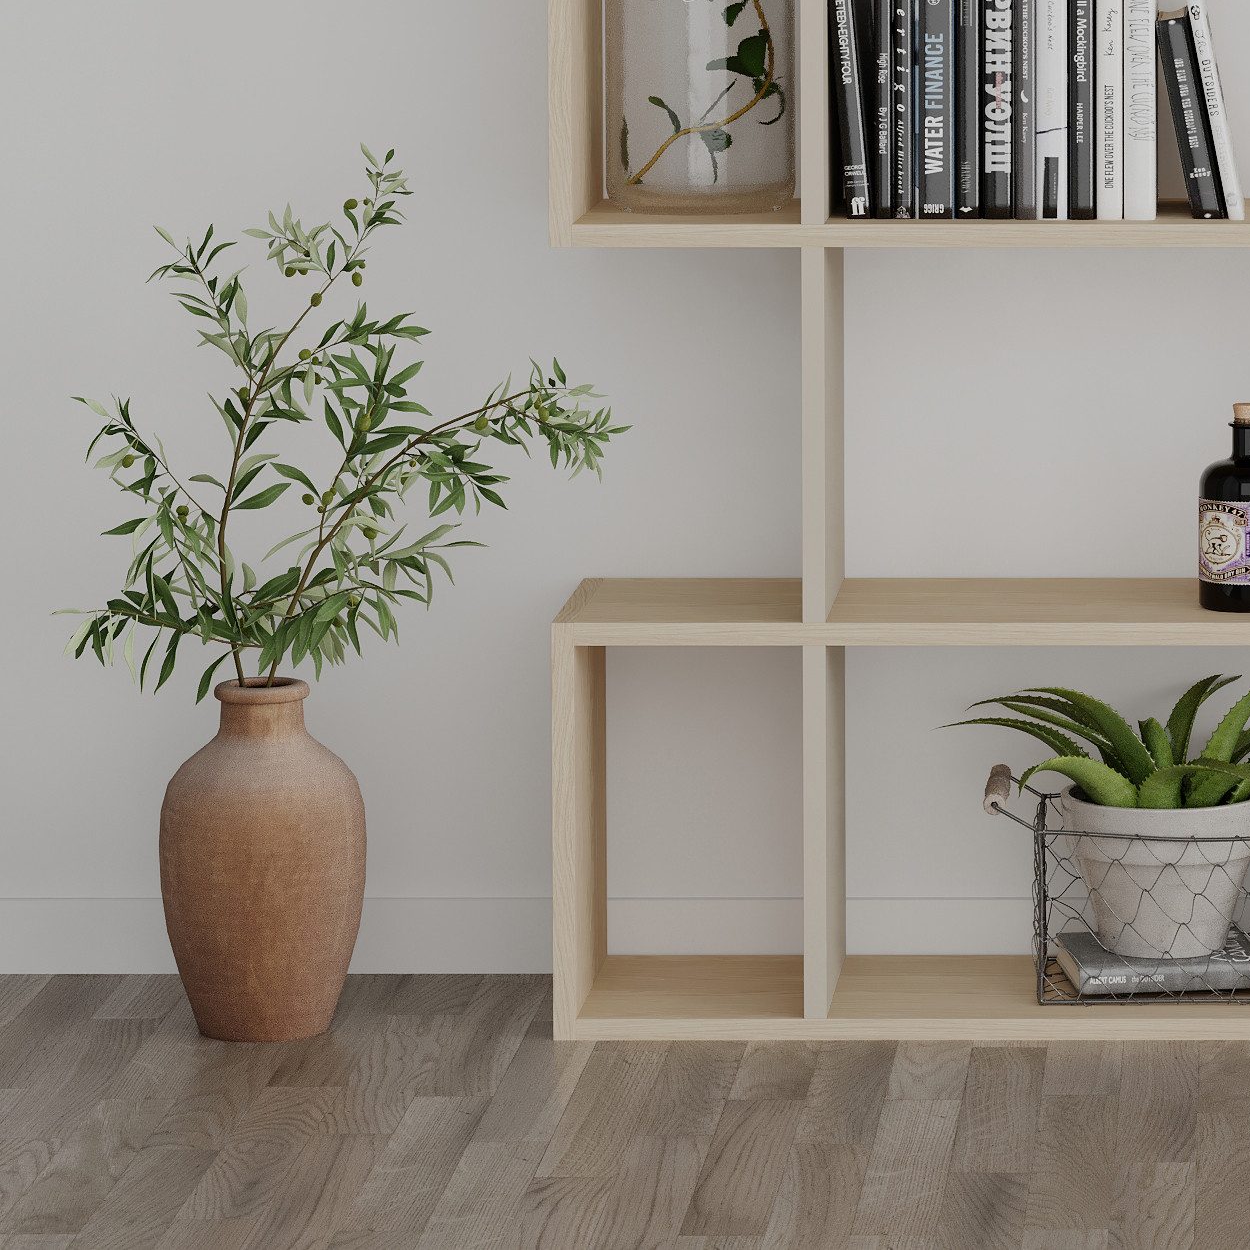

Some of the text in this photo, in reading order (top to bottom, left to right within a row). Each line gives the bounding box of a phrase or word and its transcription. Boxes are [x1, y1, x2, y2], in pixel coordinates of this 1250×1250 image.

[1074, 18, 1087, 82] Mockingbird
[840, 60, 852, 85] FOUR
[876, 52, 888, 84] High Rise
[1201, 59, 1219, 116] OUTSIDERS
[878, 107, 888, 117] By
[925, 33, 944, 175] WATER FINANCE
[878, 130, 888, 155] Ballard
[896, 119, 905, 147] Alfred
[1104, 84, 1114, 189] ONE FLEW OVER THE CUCKOO'S NEST
[923, 203, 944, 214] GRIGG
[1200, 504, 1230, 514] ONKEY
[1089, 976, 1108, 985] ALBERT
[1108, 975, 1127, 984] CAMUS
